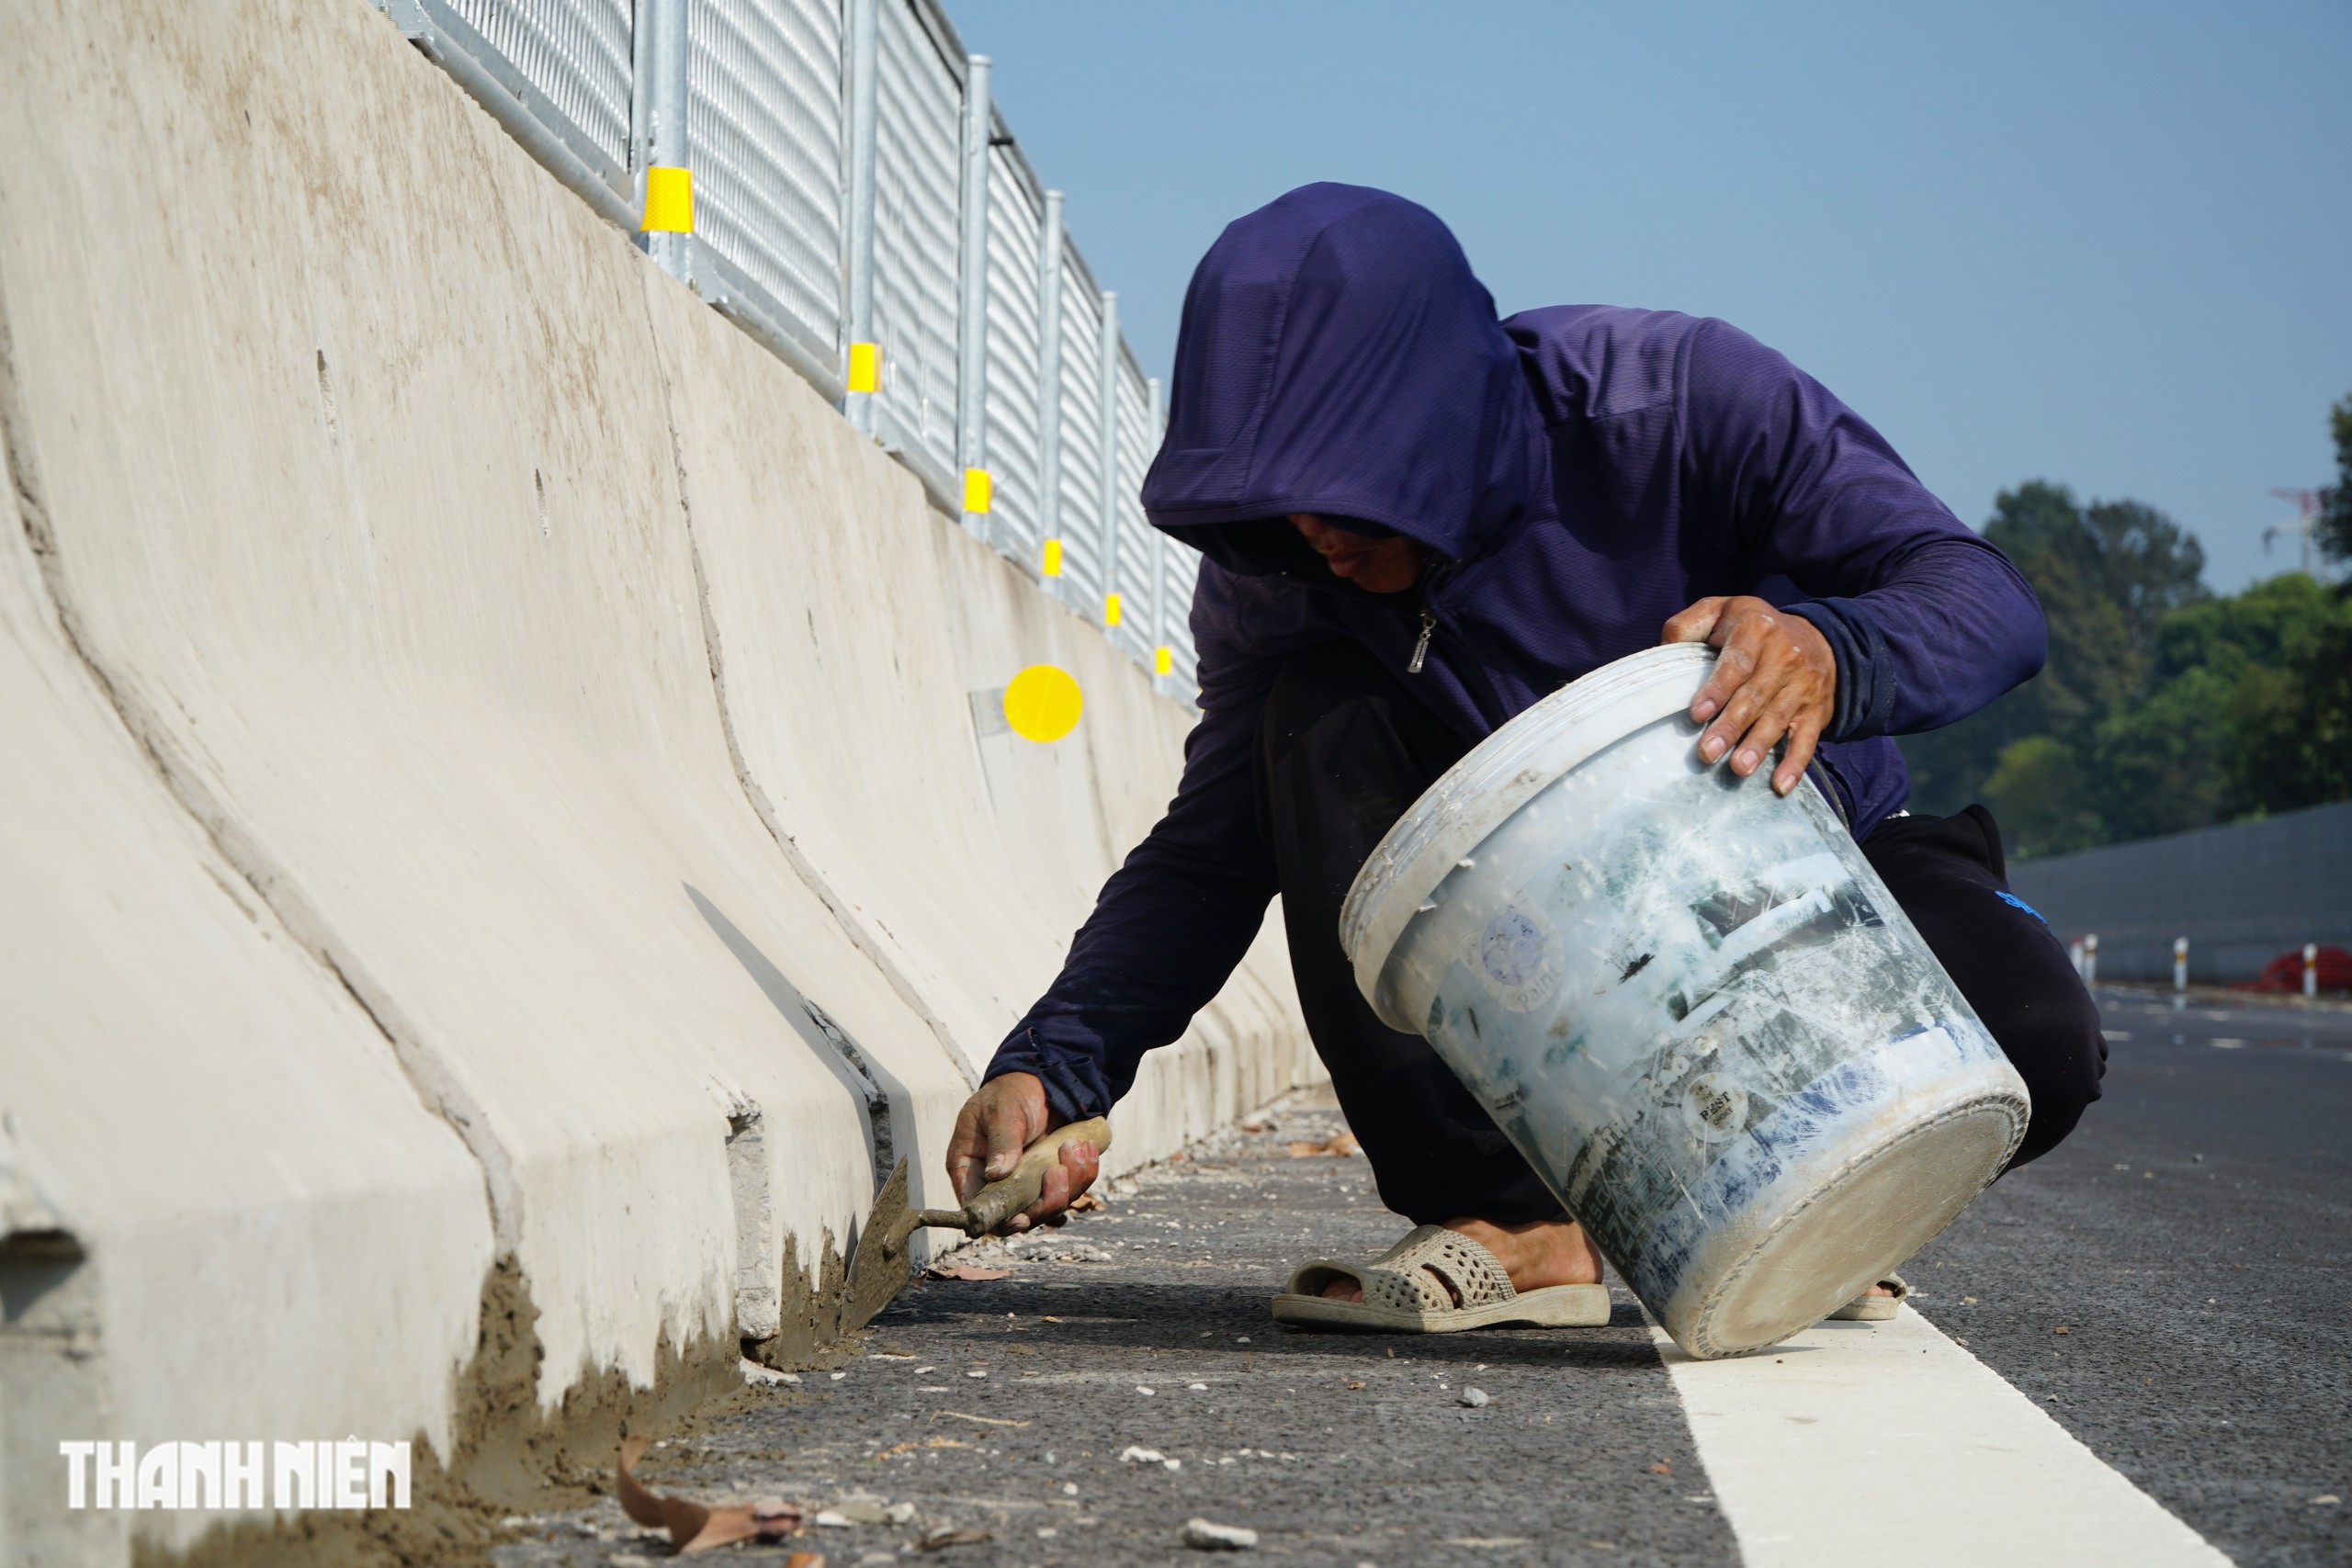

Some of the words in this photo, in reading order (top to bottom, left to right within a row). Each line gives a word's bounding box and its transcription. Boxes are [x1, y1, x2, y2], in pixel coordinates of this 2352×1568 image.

[1699, 1091, 1732, 1122] BEST
[1701, 1090, 1715, 1103] THE
[1712, 1106, 1734, 1126] CHOICE
